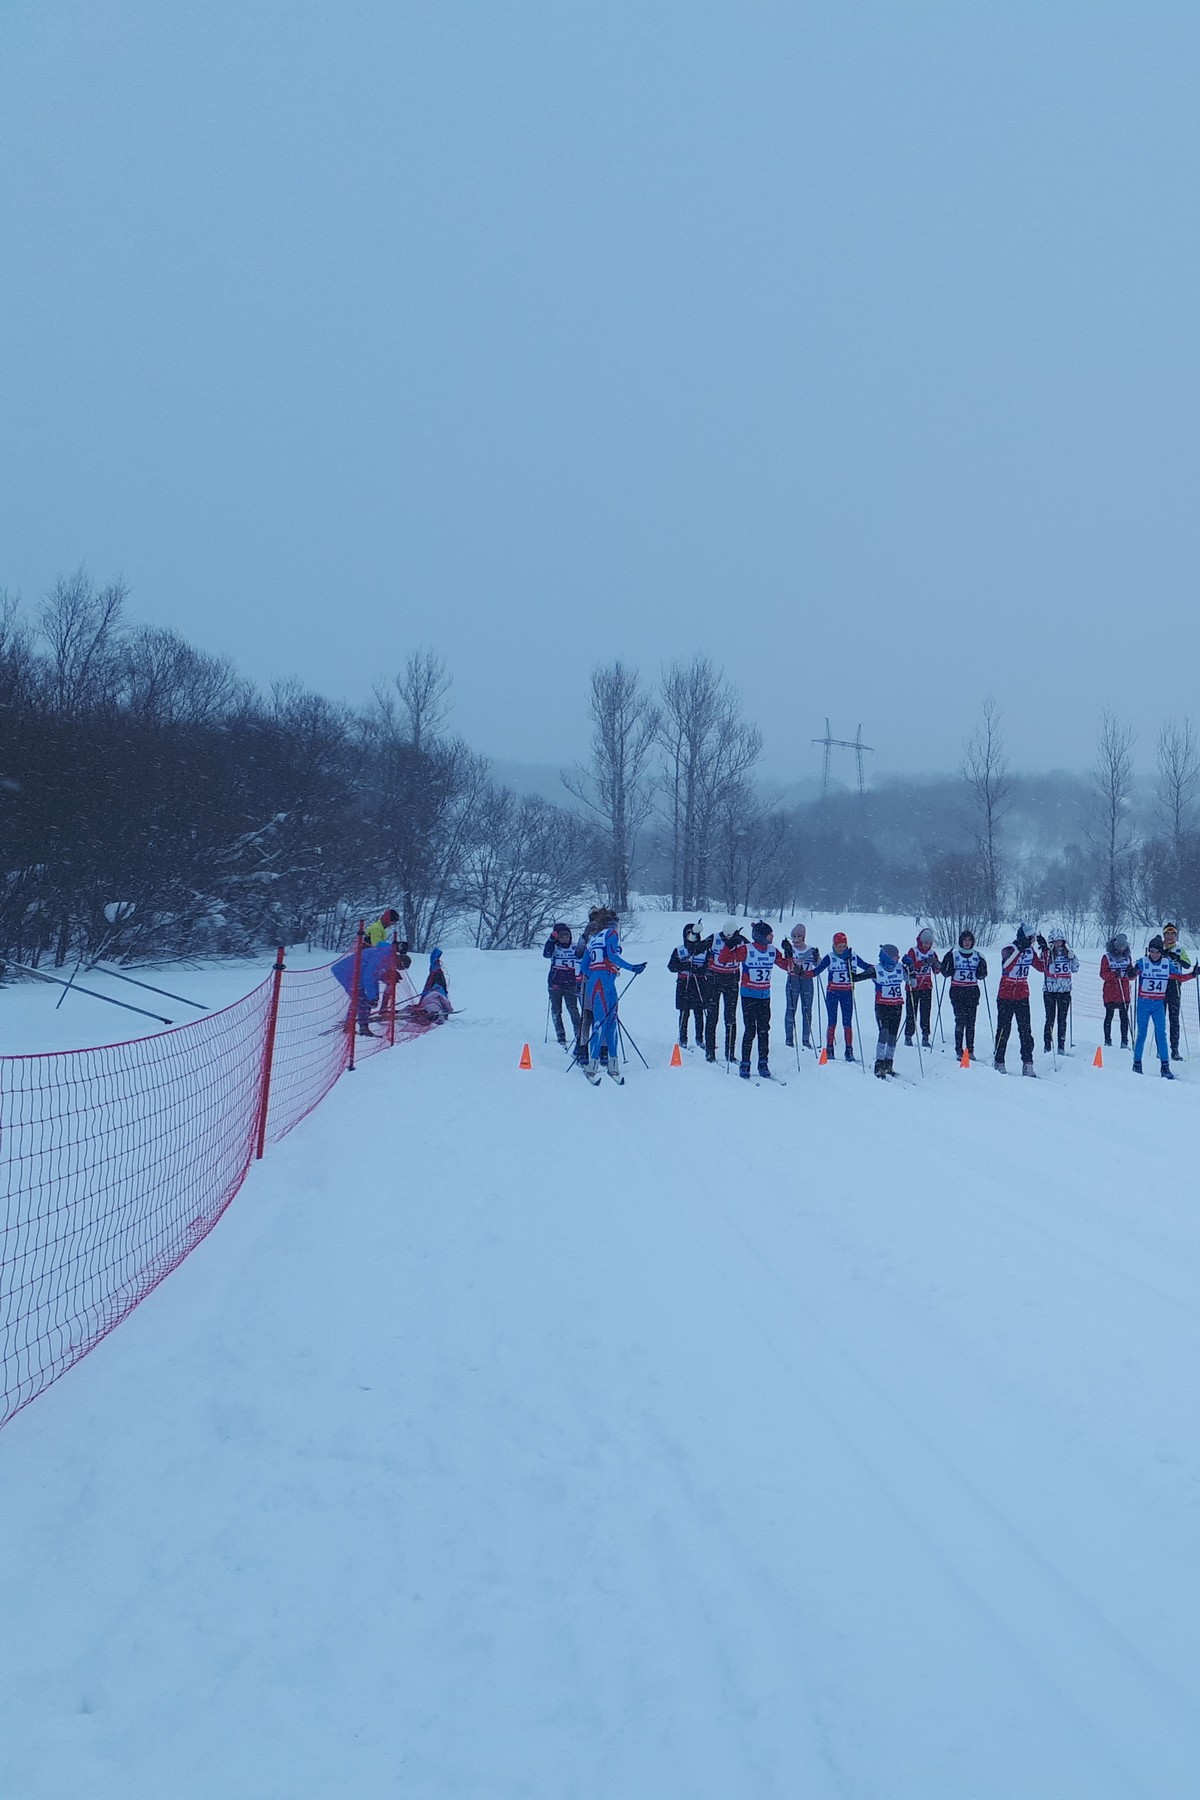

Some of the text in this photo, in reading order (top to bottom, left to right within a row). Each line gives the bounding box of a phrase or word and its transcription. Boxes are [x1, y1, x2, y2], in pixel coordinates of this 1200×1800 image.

[1016, 965, 1030, 977] 40
[1054, 963, 1069, 973] 56
[756, 969, 771, 982] 32
[959, 971, 974, 981] 54
[888, 986, 902, 998] 49
[1147, 980, 1163, 992] 34
